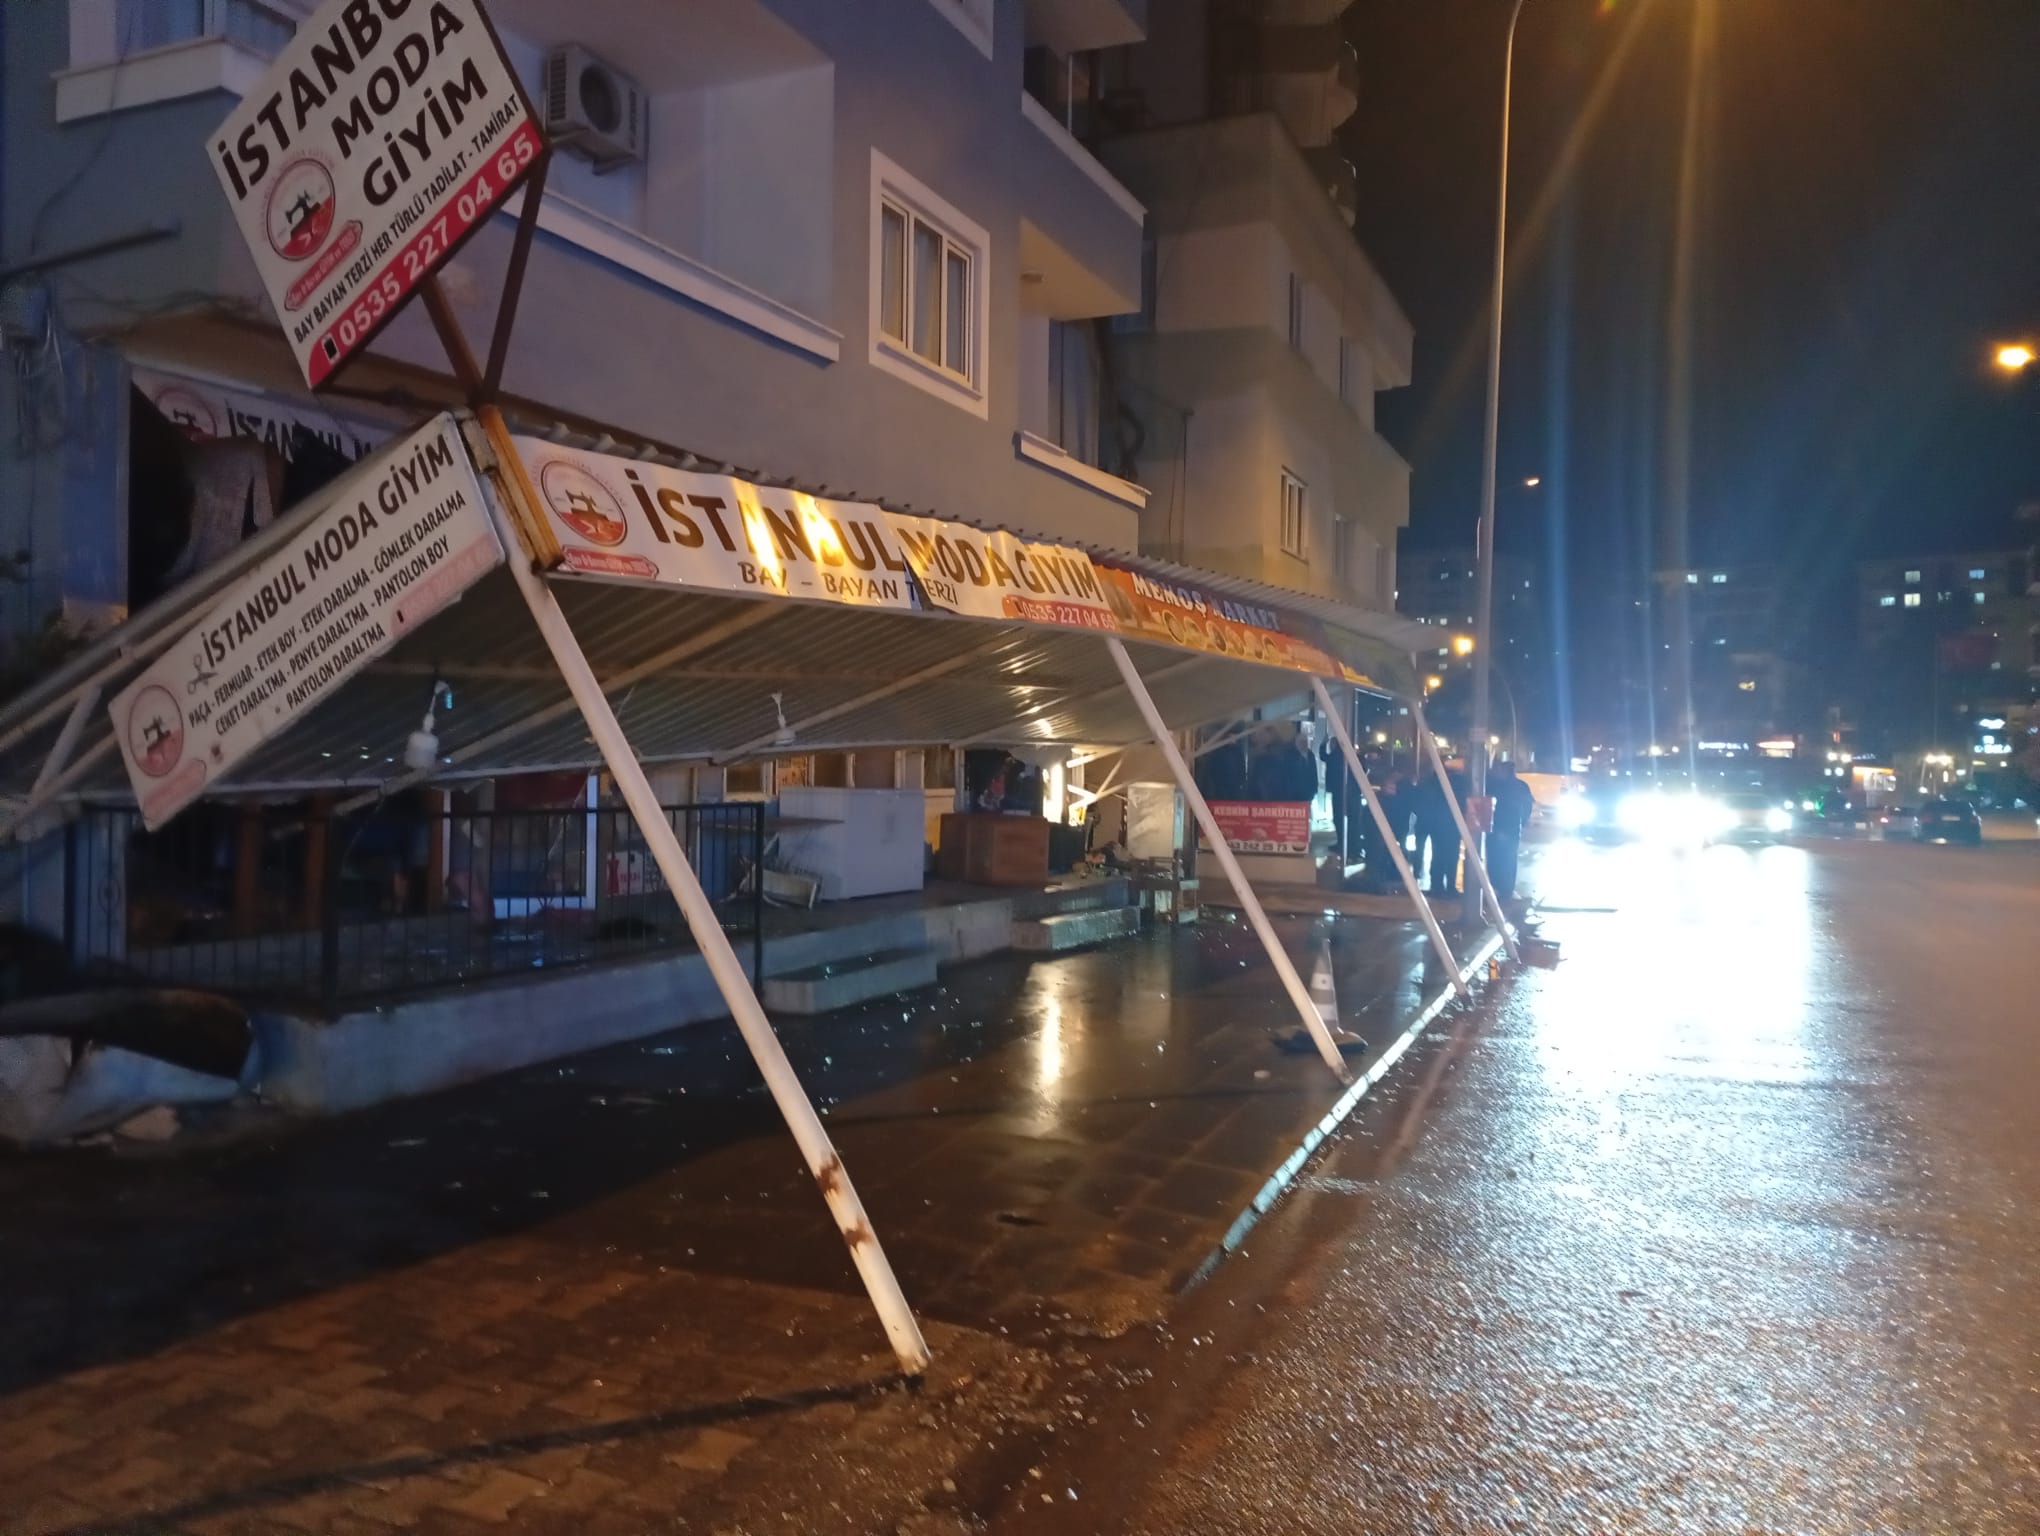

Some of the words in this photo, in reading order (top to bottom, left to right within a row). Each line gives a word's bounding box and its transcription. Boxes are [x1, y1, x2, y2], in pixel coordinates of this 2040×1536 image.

[330, 0, 464, 159] MODA
[362, 56, 489, 207] GİYİM
[293, 317, 315, 344] BAY
[315, 283, 348, 325] BAYAN
[344, 247, 373, 289] TERZİ
[369, 232, 394, 264] HER
[392, 193, 426, 239] TÜRLÜ
[424, 157, 468, 206] TADİLAT
[471, 94, 520, 154] TAMİRAT
[339, 271, 401, 347] 0535
[402, 215, 451, 282] 227
[456, 176, 494, 223] 04
[497, 132, 534, 182] 65
[224, 398, 344, 458] İSTANUL
[188, 699, 212, 729] PAÇA
[213, 664, 255, 708] FERMUAR
[256, 651, 281, 672] ETEK
[278, 626, 298, 650] BOY
[301, 608, 326, 634] ETEK
[323, 573, 371, 624] DARALMA
[373, 529, 416, 574] GÖMLEK
[413, 489, 467, 542] DARALMA
[201, 564, 305, 668] İSTANBUL
[304, 502, 378, 582] MODA
[378, 433, 454, 516] GİYİM
[822, 572, 899, 600] BAYAN
[896, 526, 1021, 589] MODA
[1014, 544, 1104, 603] GİYİM
[1022, 601, 1058, 622] 0535
[1057, 605, 1082, 625] 227
[1083, 609, 1101, 629] 04
[1100, 612, 1117, 631] 65
[215, 706, 242, 737] CEKET
[240, 669, 288, 717] DARALTMA
[289, 645, 320, 675] PENYE
[316, 602, 370, 655] DARALTMA
[373, 553, 429, 608] PANTOLON
[426, 533, 450, 566] BOY
[285, 660, 335, 711] PANTOLON
[332, 622, 386, 673] DARALTMA
